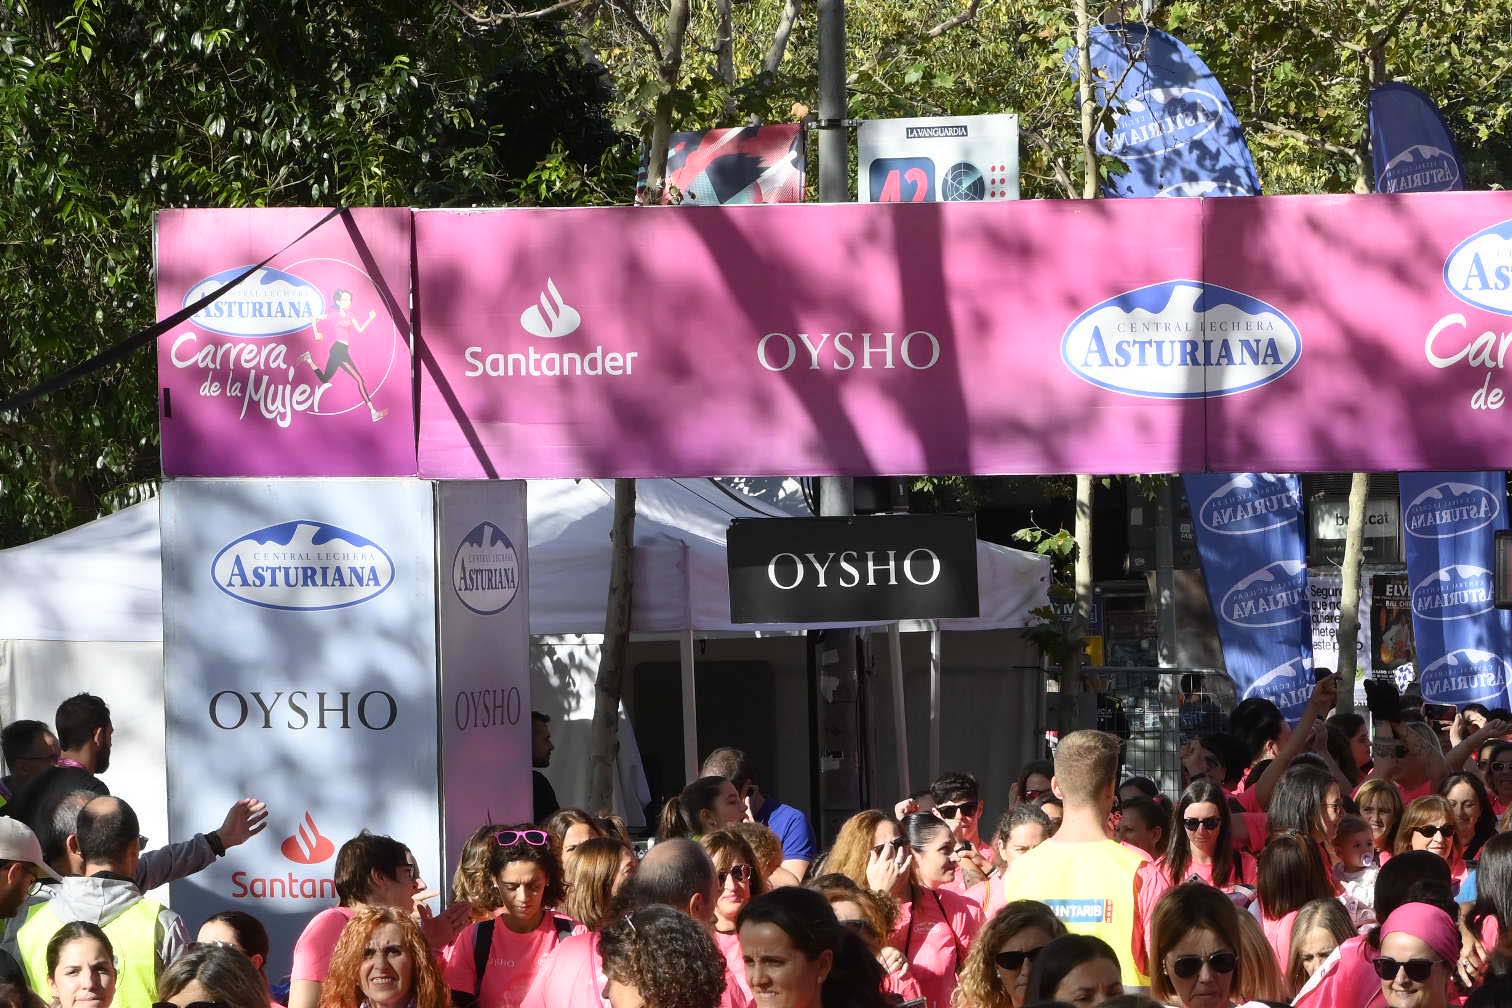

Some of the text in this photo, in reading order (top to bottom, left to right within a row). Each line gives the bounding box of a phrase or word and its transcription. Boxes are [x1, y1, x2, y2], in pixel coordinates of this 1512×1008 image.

[1118, 321, 1275, 332] CENTRAL LECHERA
[170, 332, 288, 369] Carrera
[465, 345, 638, 377] Santander
[757, 331, 940, 373] OYSHO
[1081, 325, 1284, 367] ASTURIANA
[200, 366, 332, 427] de la Mujer
[1471, 372, 1505, 410] de
[226, 554, 382, 588] ASTURIANA
[253, 552, 376, 561] CENTRAL LECHERA
[458, 556, 516, 592] ASTURIANA
[768, 548, 941, 589] OYSHO
[209, 690, 398, 731] OYSHO
[455, 686, 521, 731] OYSHO
[231, 871, 338, 899] Santan
